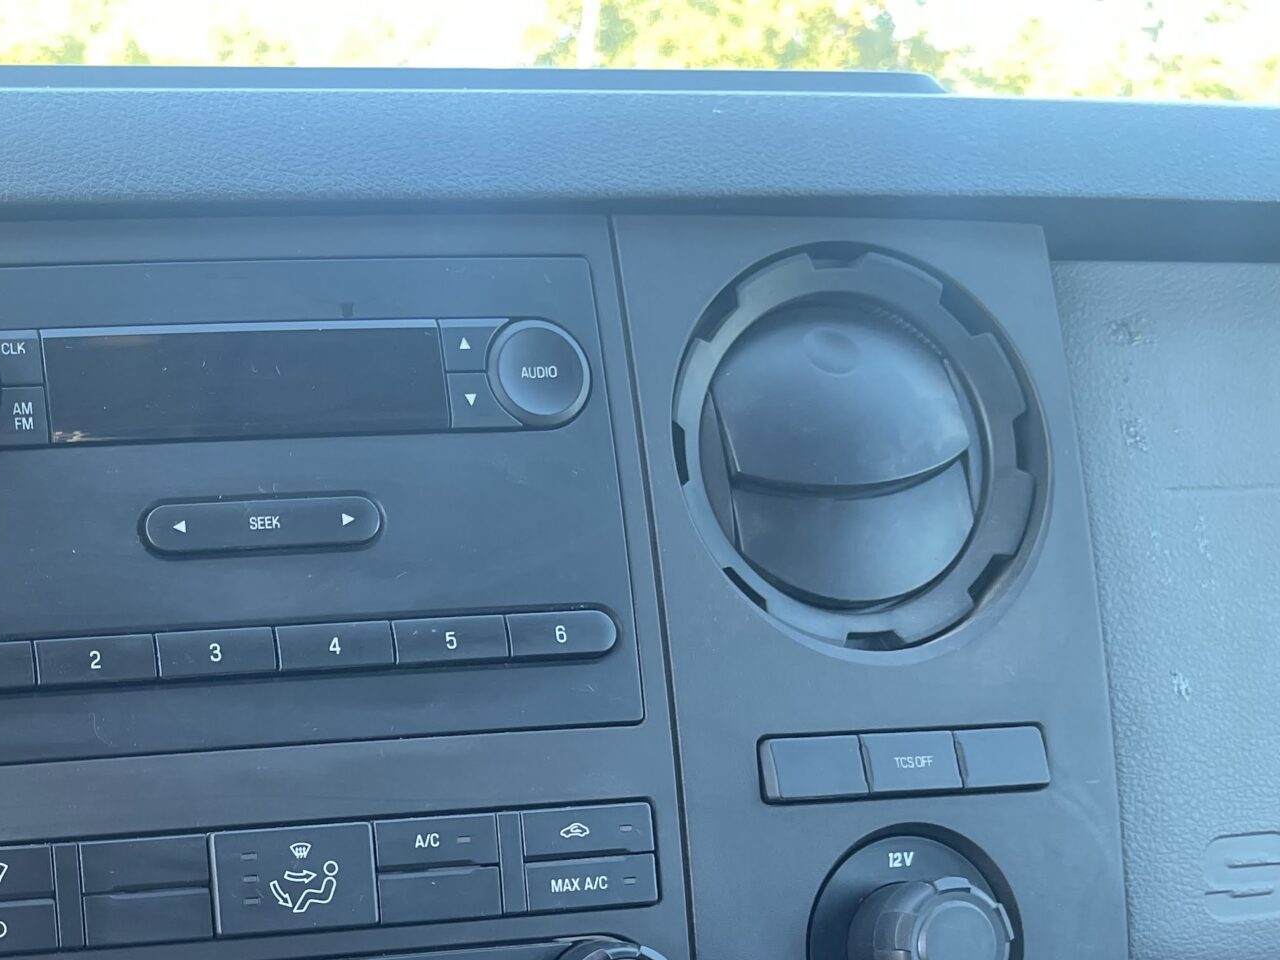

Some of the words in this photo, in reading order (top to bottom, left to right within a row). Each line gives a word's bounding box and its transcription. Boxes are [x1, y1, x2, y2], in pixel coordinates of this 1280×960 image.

[1, 342, 26, 355] CLK
[521, 365, 558, 379] AUDIO
[13, 402, 33, 416] AM
[14, 417, 34, 430] FM
[249, 515, 281, 530] SEEK
[445, 631, 457, 649] 5
[555, 625, 567, 643] 6
[209, 643, 222, 662] 3
[328, 637, 341, 655] 4
[89, 650, 102, 669] 2
[894, 756, 915, 769] TCS
[915, 755, 934, 768] OFF
[415, 833, 440, 848] A/C
[551, 877, 580, 892] MAX
[584, 876, 608, 890] A/C
